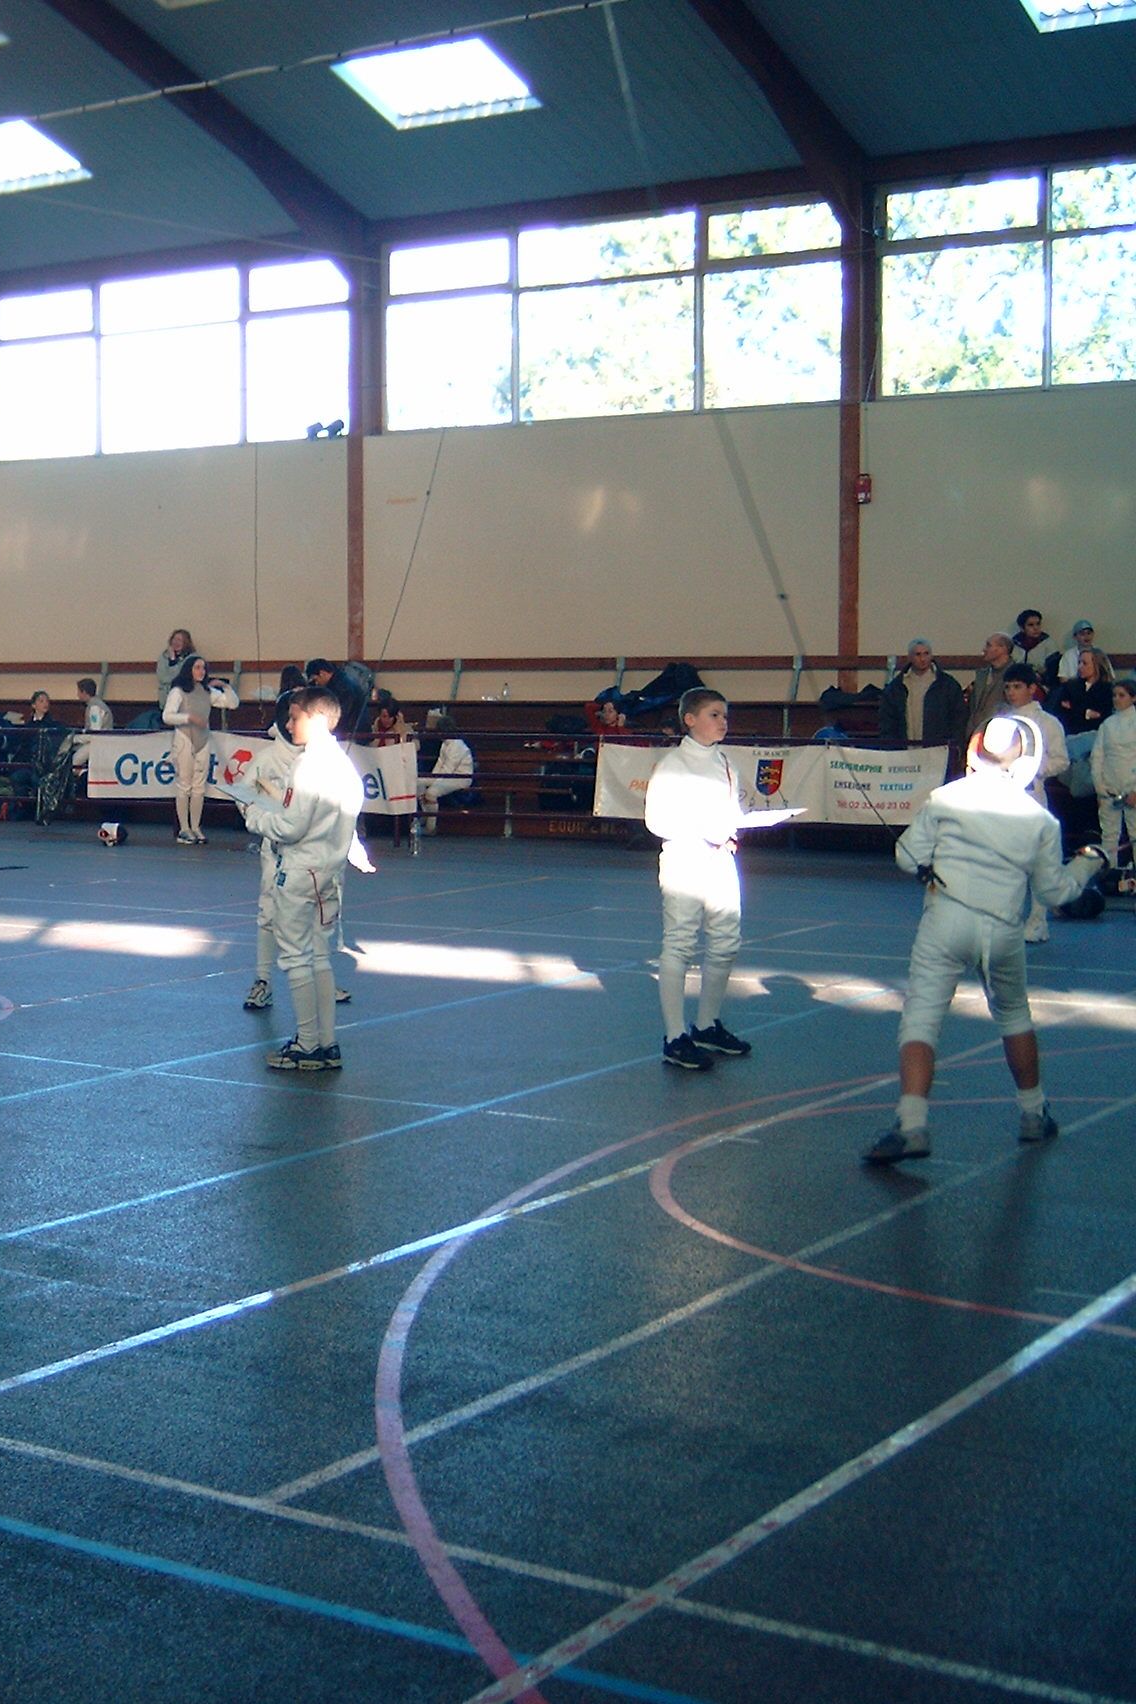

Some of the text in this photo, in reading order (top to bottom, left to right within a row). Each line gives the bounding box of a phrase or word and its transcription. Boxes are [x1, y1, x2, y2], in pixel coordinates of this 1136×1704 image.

[114, 751, 219, 785] Crét
[849, 800, 860, 809] 02
[899, 802, 912, 810] 02
